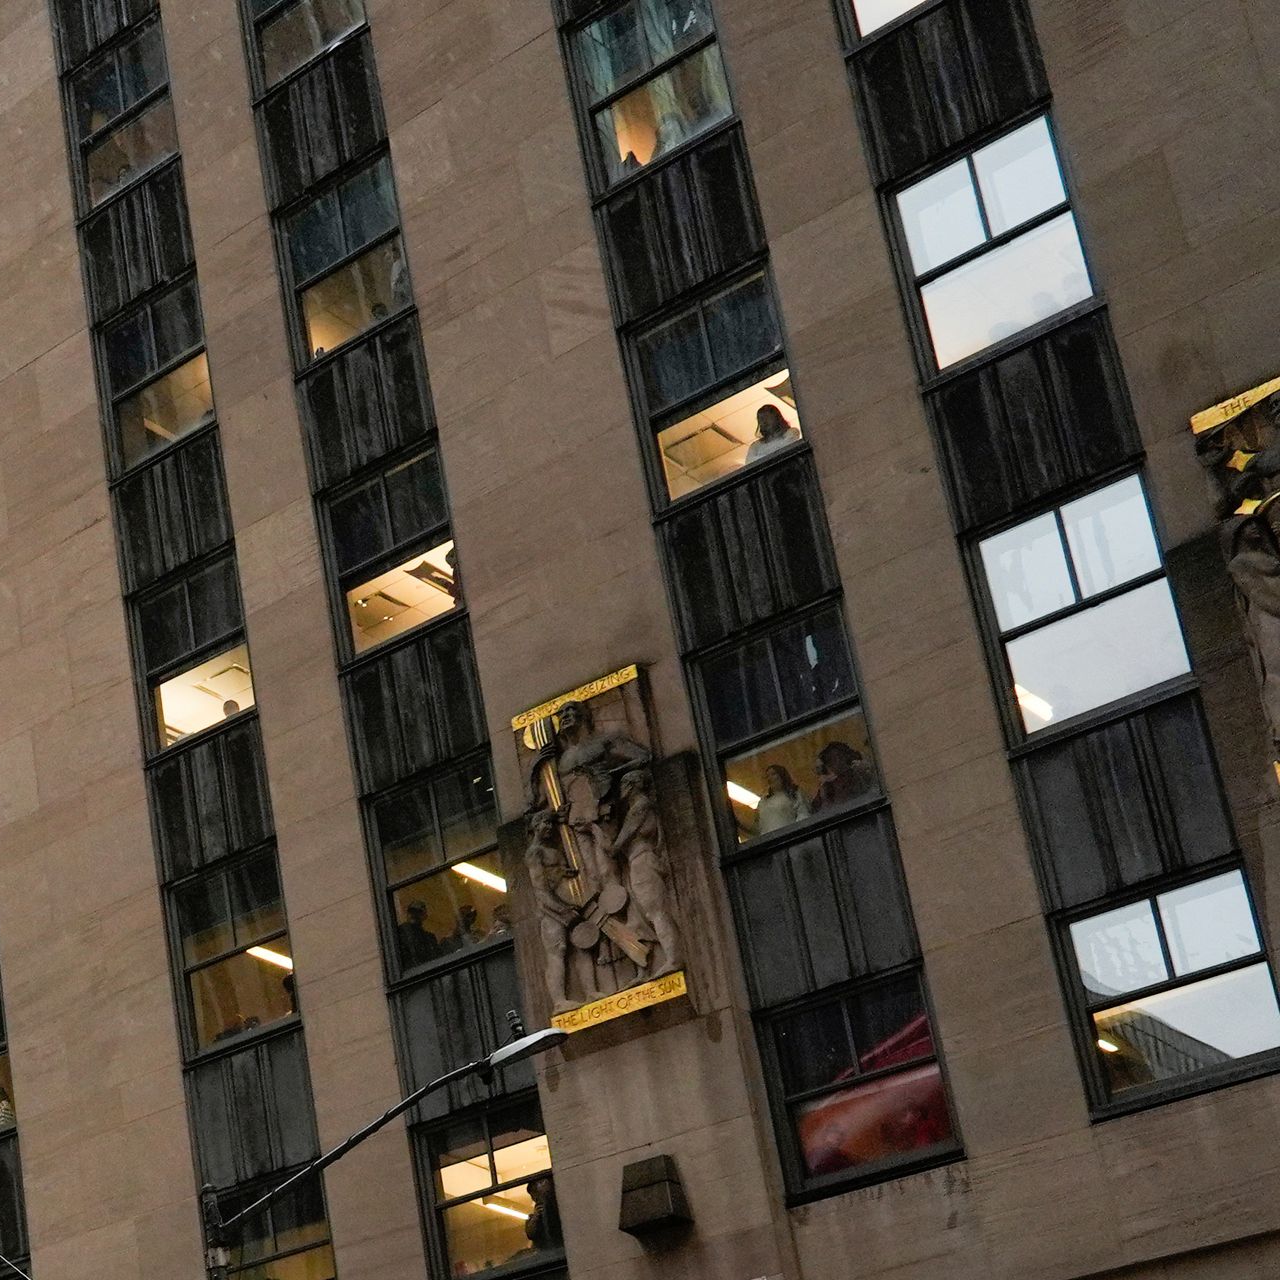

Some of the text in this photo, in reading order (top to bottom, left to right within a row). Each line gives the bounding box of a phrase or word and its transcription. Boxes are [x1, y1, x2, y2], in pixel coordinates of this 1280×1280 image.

[582, 669, 631, 697] SEIZING
[556, 978, 682, 1028] THE LIGHT OF THE SUN
